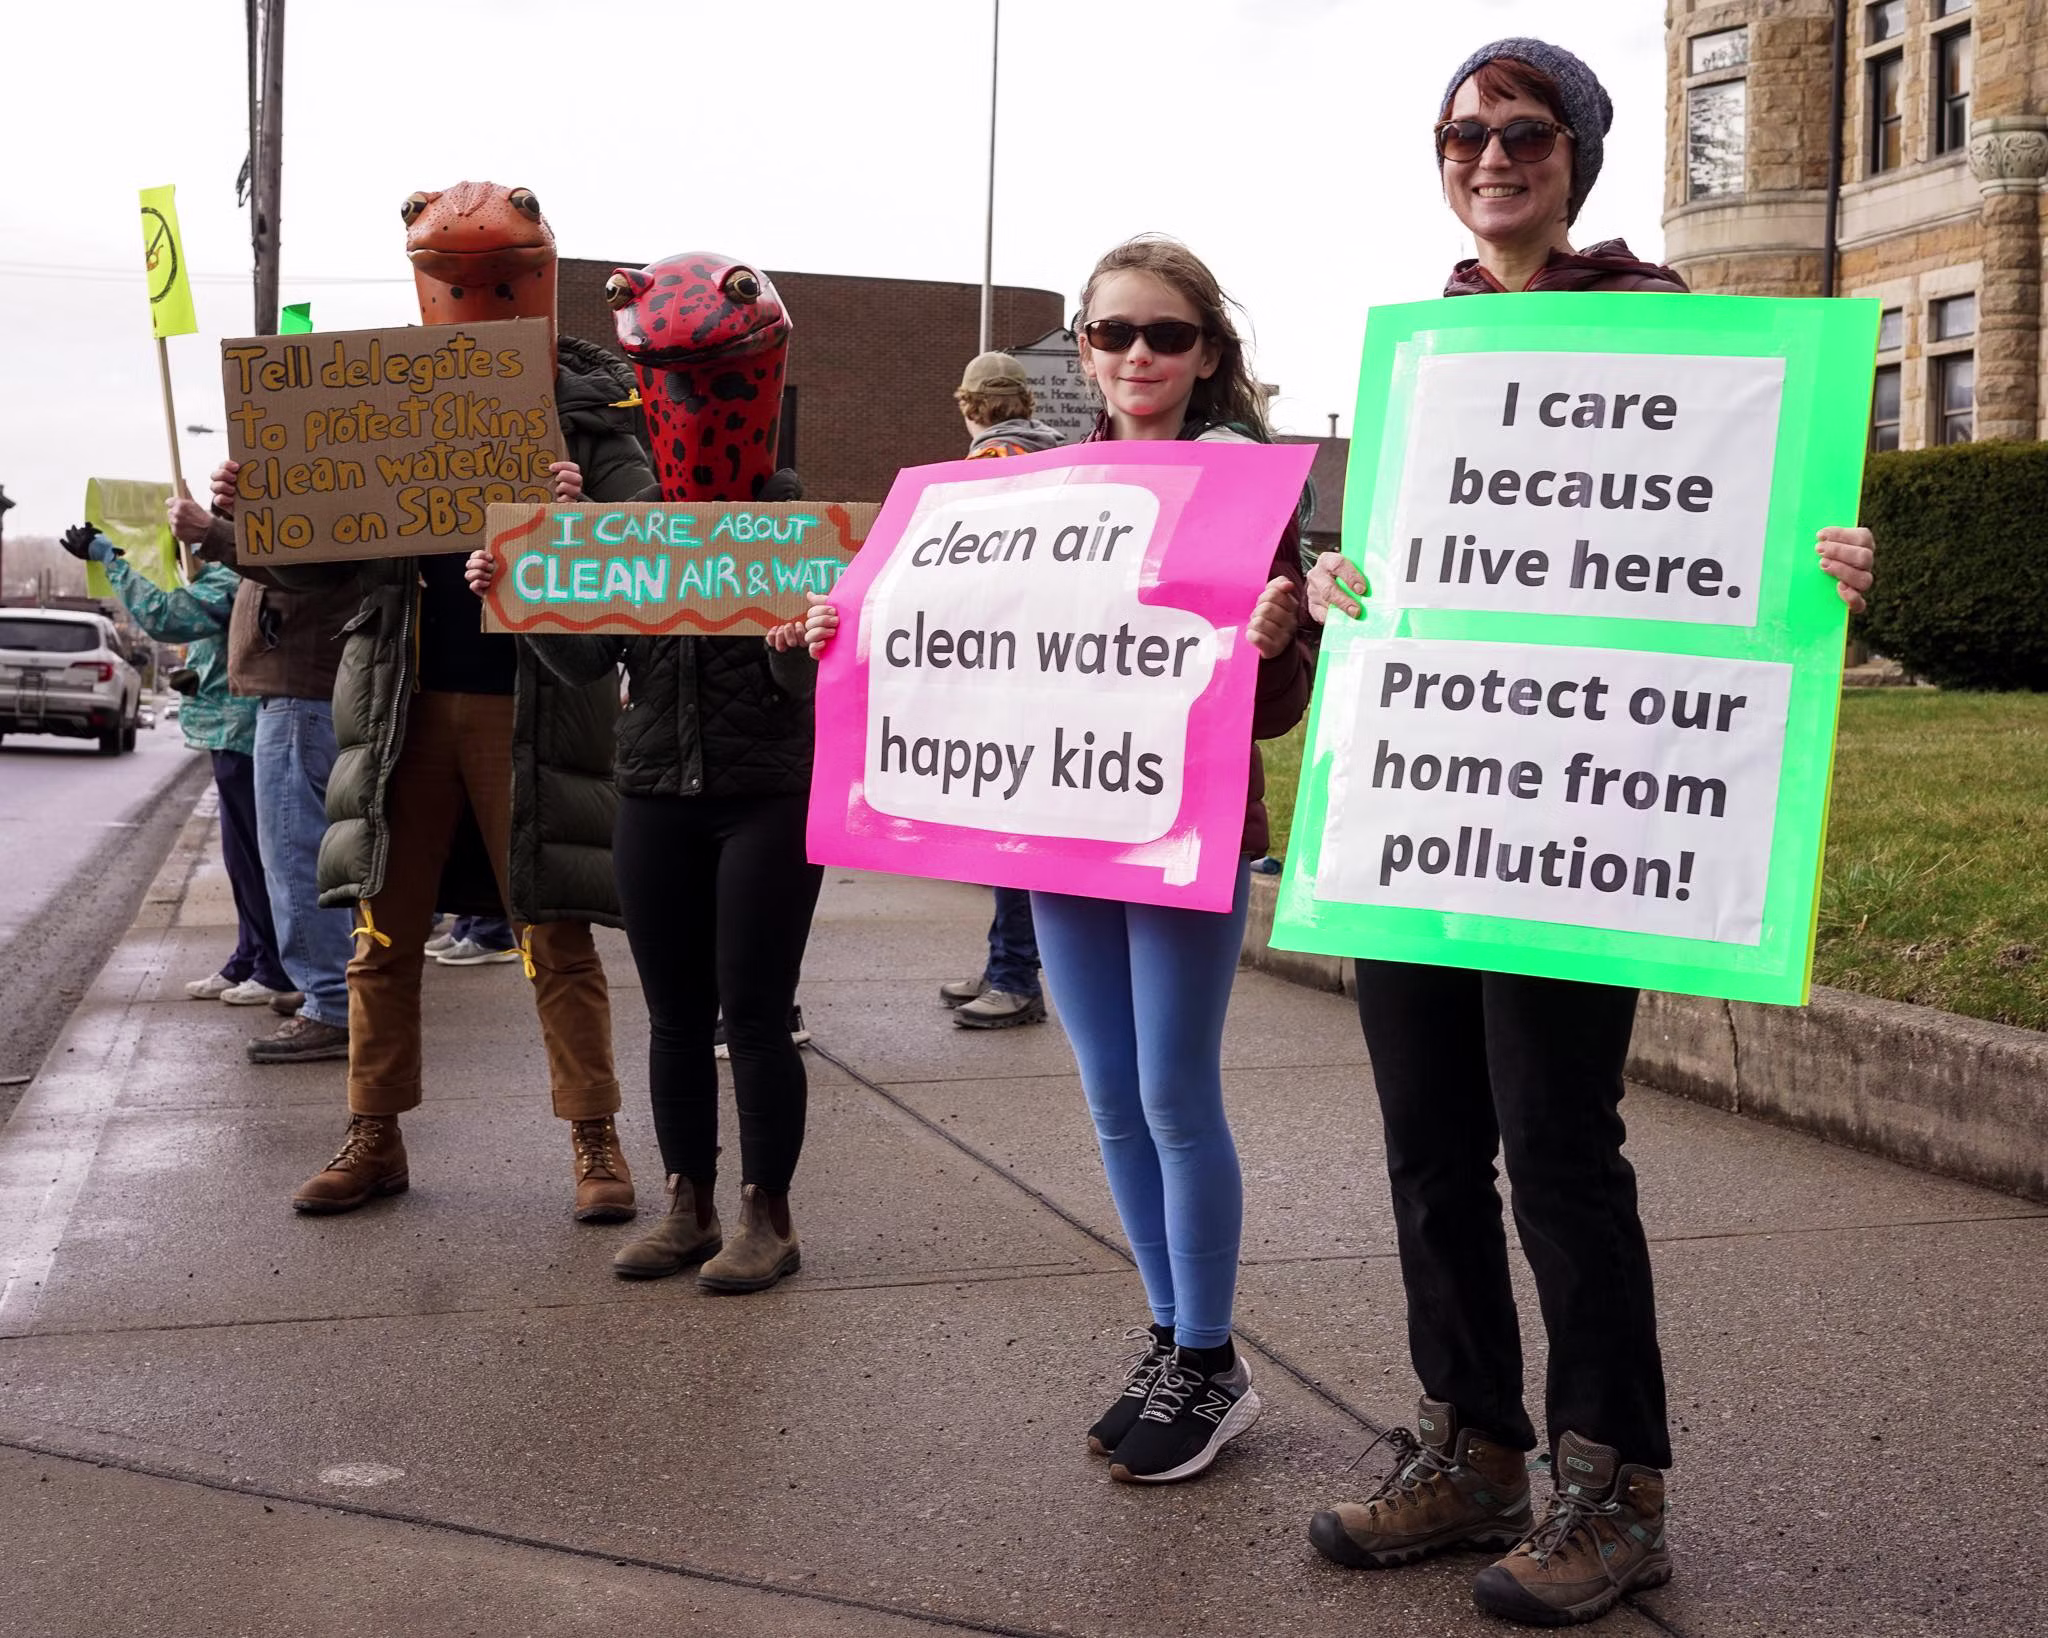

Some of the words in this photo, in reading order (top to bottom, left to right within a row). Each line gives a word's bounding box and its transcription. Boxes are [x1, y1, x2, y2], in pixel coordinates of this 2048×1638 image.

[224, 346, 312, 394] Tell
[320, 331, 524, 394] delegates
[304, 395, 432, 453] protect
[1502, 382, 1520, 427] I
[1538, 390, 1678, 431] care
[375, 441, 489, 487] water
[1449, 457, 1714, 513] because
[245, 506, 313, 555] No
[331, 511, 387, 544] on
[550, 512, 584, 547] I
[593, 509, 704, 547] CARE
[711, 511, 821, 544] ABOUT
[911, 521, 1037, 567] clean
[1052, 510, 1133, 562] air
[513, 550, 670, 608] CLEAN
[677, 555, 741, 600] AIR
[746, 561, 772, 597] &
[1405, 537, 1423, 583] I
[1438, 534, 1550, 587] live
[1569, 539, 1742, 599] here.
[885, 611, 1016, 670] clean
[1036, 623, 1200, 677] water
[1379, 662, 1609, 721] Protect
[1628, 686, 1748, 732] our
[880, 716, 1035, 800] happy
[1051, 727, 1164, 795] kids
[1371, 739, 1544, 800] home
[1564, 752, 1727, 818] from
[1378, 825, 1696, 901] pollution!
